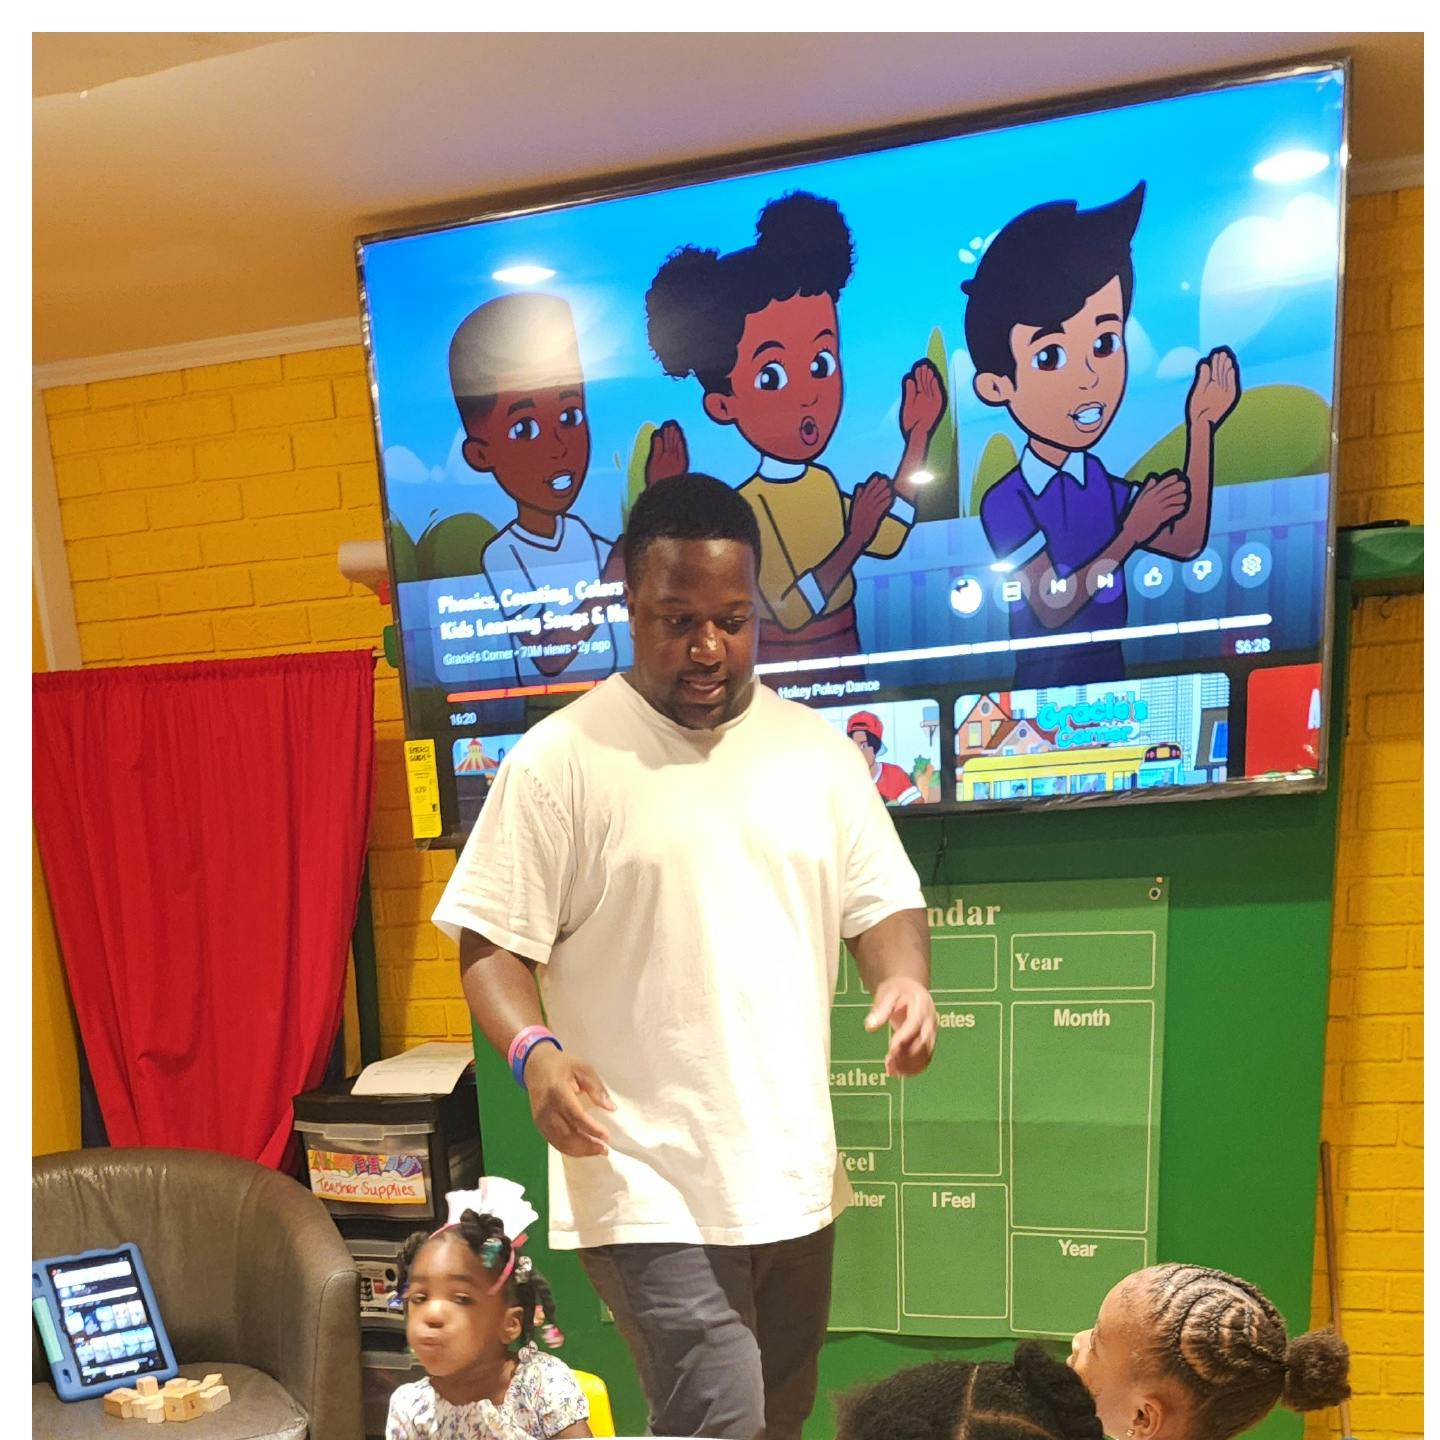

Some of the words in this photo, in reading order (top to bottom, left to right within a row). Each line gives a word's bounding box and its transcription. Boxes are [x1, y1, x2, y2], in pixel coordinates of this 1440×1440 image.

[437, 591, 500, 614] Phonics,
[502, 582, 574, 608] Counting,
[440, 621, 474, 641] Kids
[476, 614, 542, 637] Learning
[543, 609, 589, 631] Songs
[590, 605, 604, 624] &
[442, 651, 482, 667] Gracie's
[482, 647, 514, 664] Corner
[543, 642, 573, 658] views
[591, 639, 611, 655] ago
[1234, 637, 1272, 655] 56:28
[778, 683, 811, 700] Hokey
[812, 680, 845, 697] Pokey
[845, 677, 880, 694] Dance
[449, 711, 477, 728] 16:20
[927, 900, 1000, 927] ndar
[1015, 953, 1063, 972] Year
[1053, 1008, 1112, 1028] Month
[829, 1068, 889, 1088] eather
[362, 1181, 417, 1201] Supplies
[848, 1191, 886, 1208] ather
[931, 1192, 937, 1209] I
[940, 1191, 976, 1209] Feel
[1058, 1239, 1098, 1258] Year
